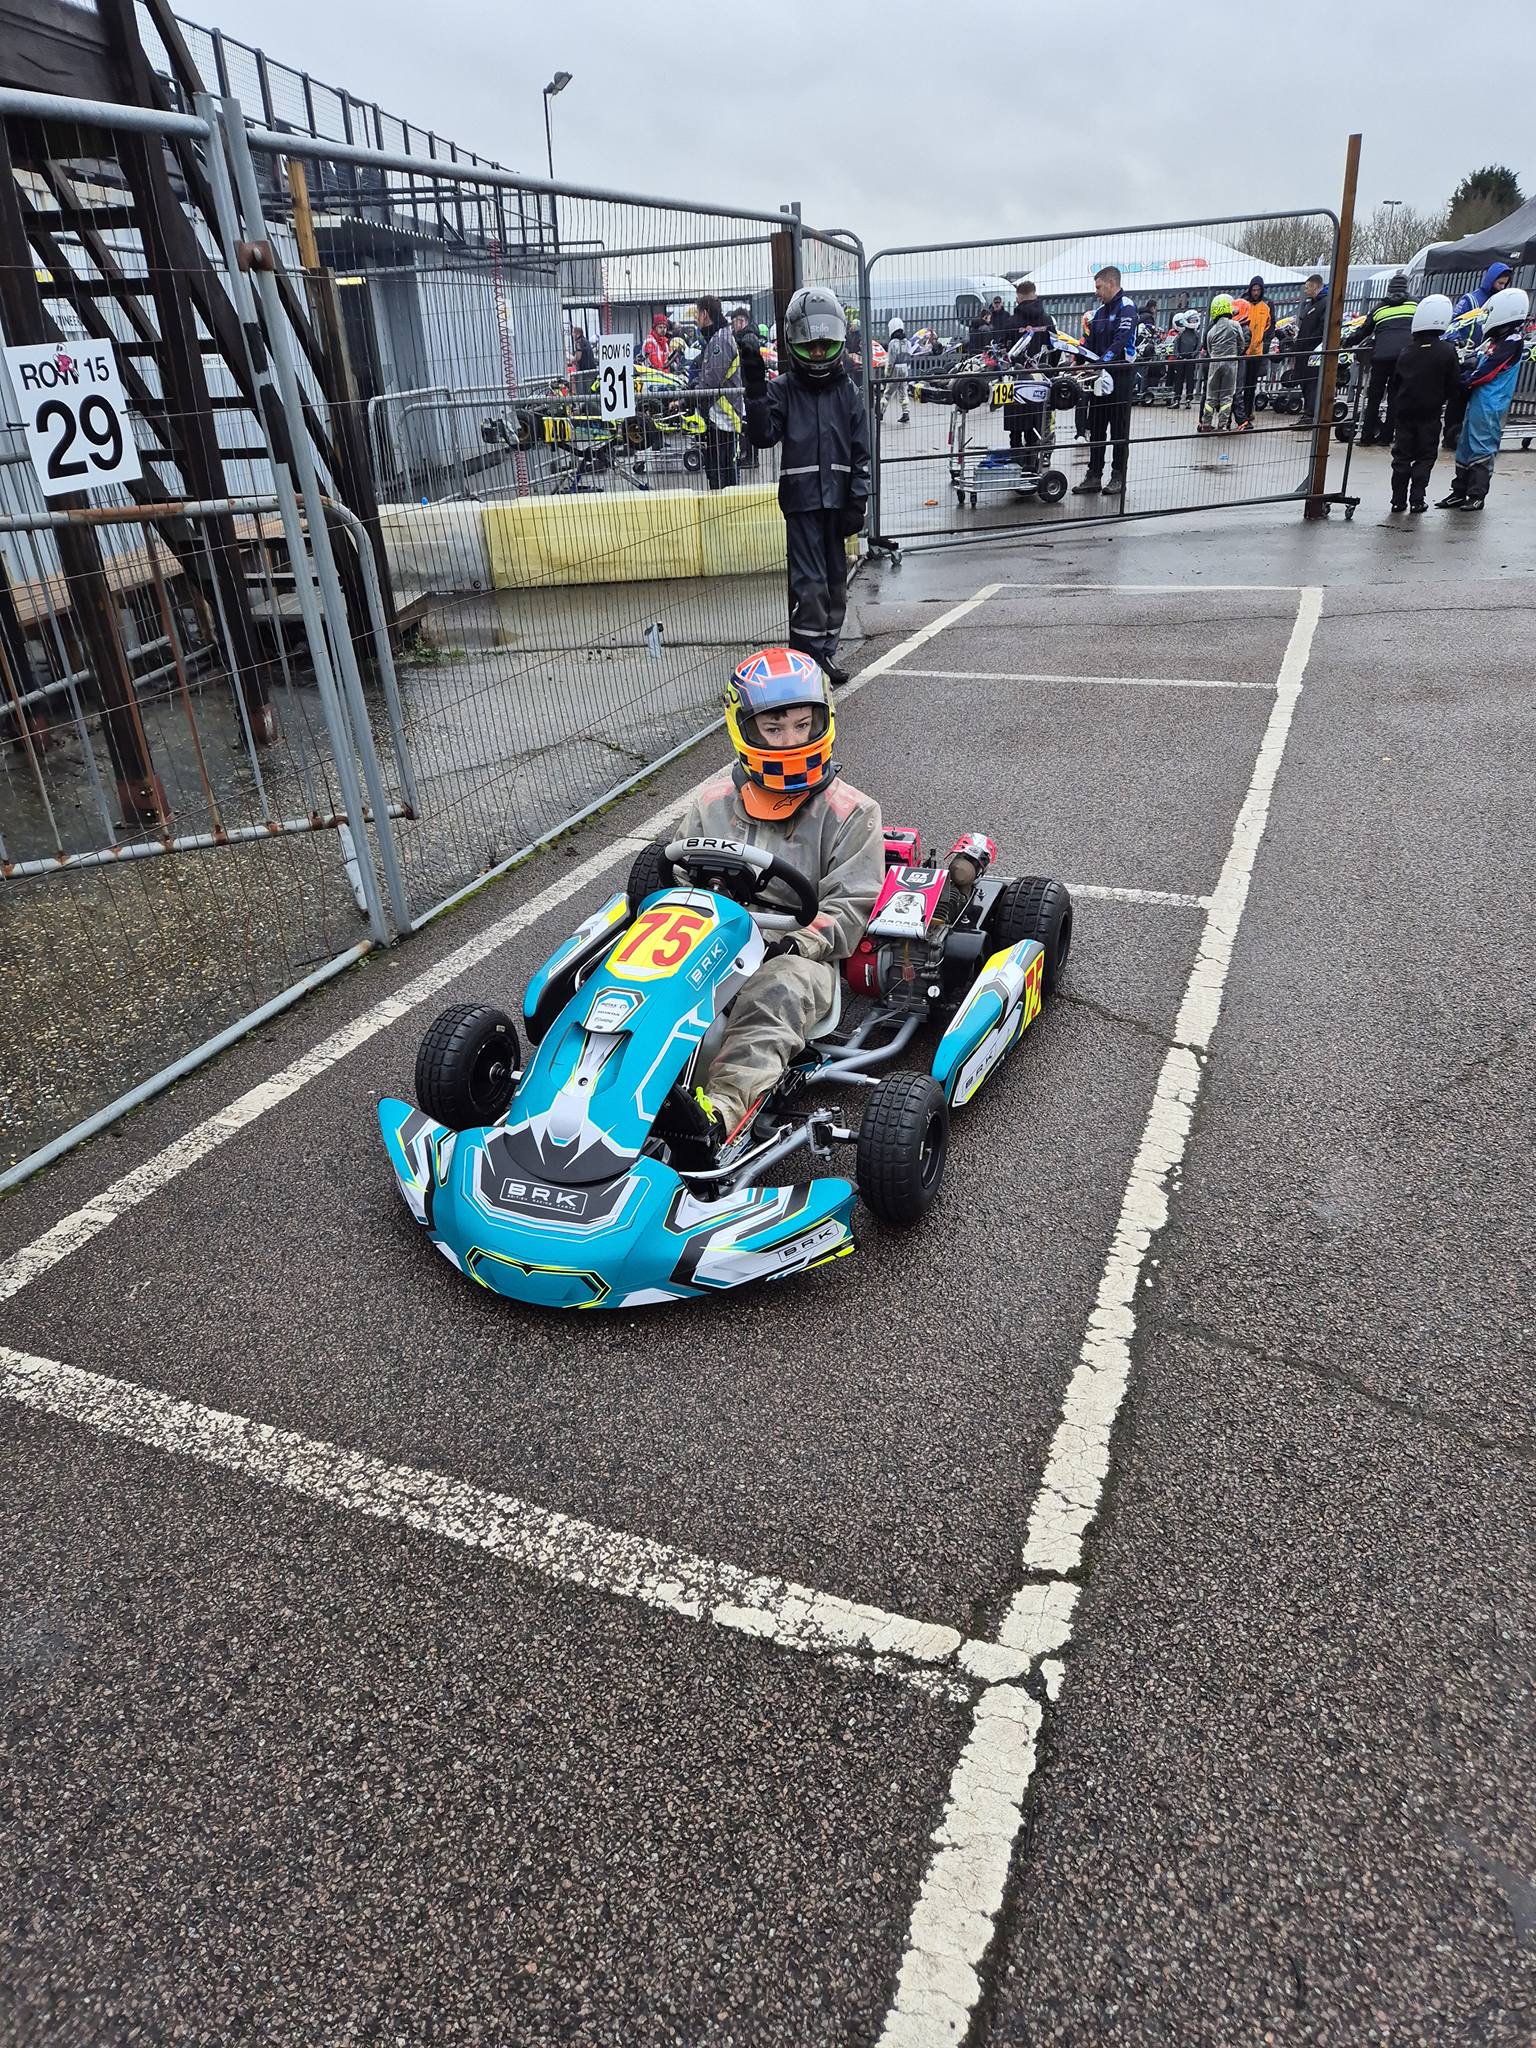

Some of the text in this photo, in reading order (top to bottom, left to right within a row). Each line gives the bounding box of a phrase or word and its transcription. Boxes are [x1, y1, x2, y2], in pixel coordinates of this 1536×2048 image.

[602, 343, 631, 360] ROW 16
[19, 356, 110, 390] ROW 15
[603, 365, 628, 412] 31
[995, 384, 1014, 404] 194
[36, 394, 123, 479] 29
[686, 838, 738, 852] BRK
[617, 913, 705, 967] 75
[691, 943, 723, 982] BRK
[1023, 953, 1043, 1031] 75
[965, 1054, 993, 1089] BRK
[508, 1182, 578, 1207] BRK
[784, 1229, 832, 1256] BRK
